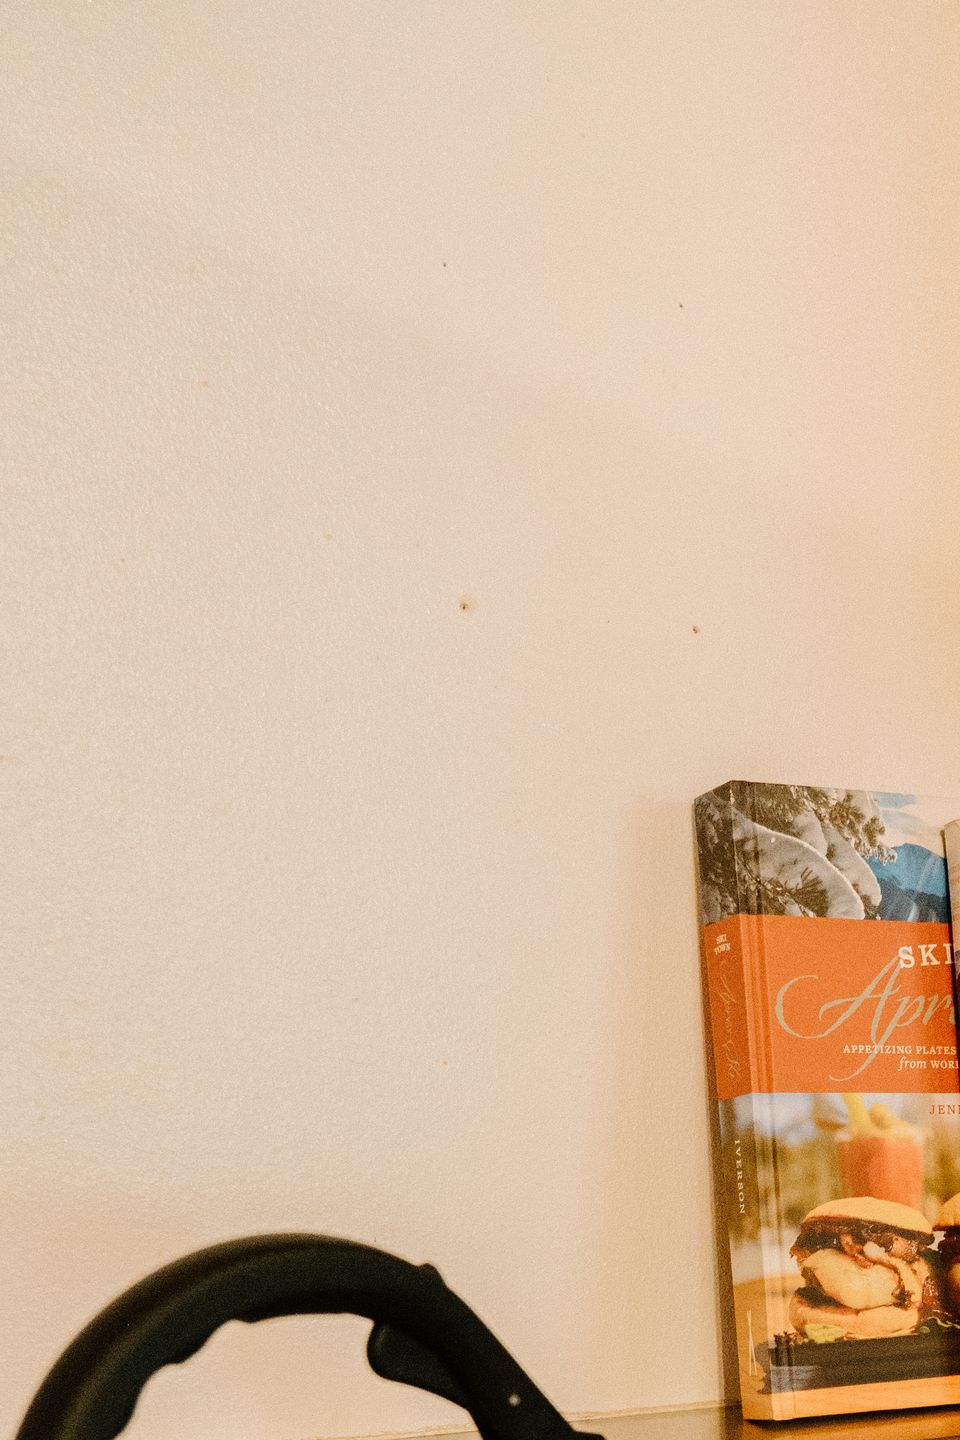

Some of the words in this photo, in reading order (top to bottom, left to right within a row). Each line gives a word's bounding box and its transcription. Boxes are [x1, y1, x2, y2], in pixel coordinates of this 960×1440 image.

[898, 943, 953, 969] SKI
[842, 1044, 912, 1055] APPETIZING
[915, 1045, 957, 1056] PLATES
[898, 1055, 928, 1072] from
[733, 1140, 746, 1215] IVERSON
